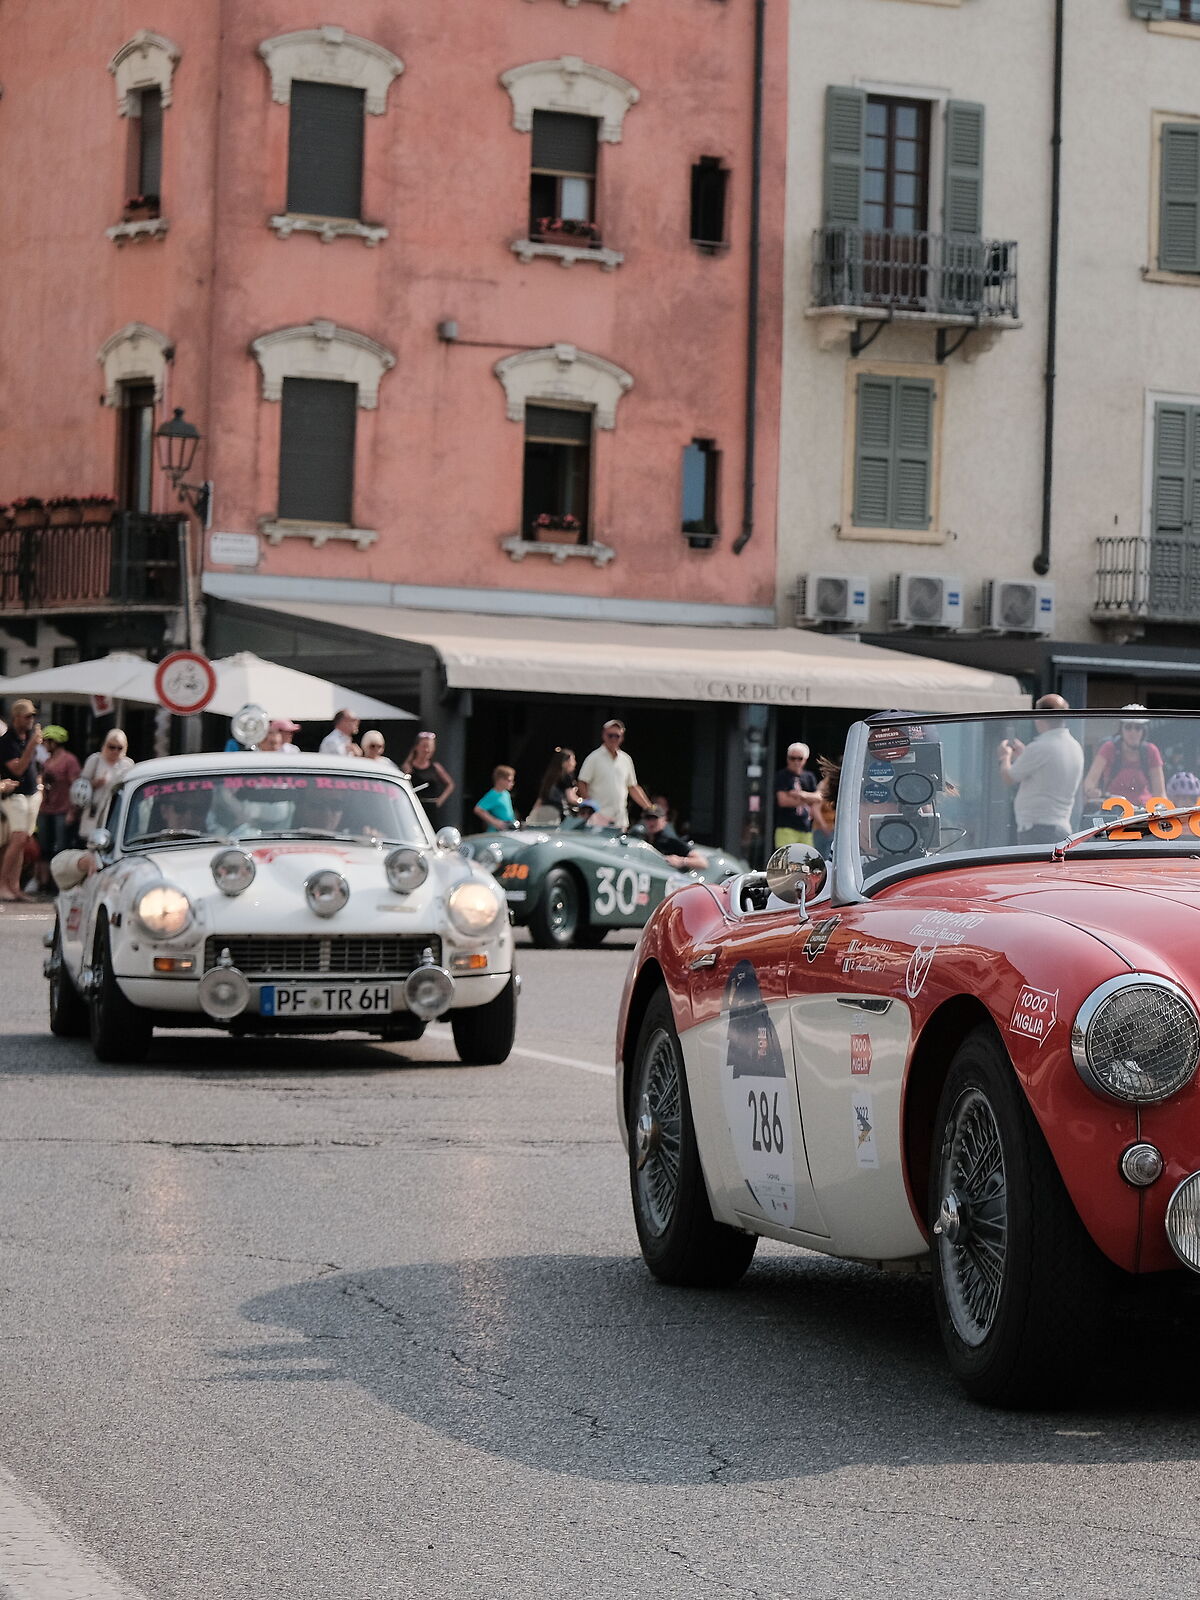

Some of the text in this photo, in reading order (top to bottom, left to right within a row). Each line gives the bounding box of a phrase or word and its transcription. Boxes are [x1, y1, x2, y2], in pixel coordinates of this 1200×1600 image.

[707, 680, 811, 702] CARDUCCI
[143, 776, 400, 800] Extra Mobile Racing
[921, 910, 985, 929] CHOPARD
[909, 924, 966, 946] Classic Racing
[276, 988, 389, 1011] PF TR 6H
[1020, 991, 1049, 1013] 1000
[1012, 1011, 1044, 1036] MIGLIA
[852, 1038, 867, 1052] 1000
[851, 1057, 869, 1071] MIGLIA
[748, 1090, 784, 1154] 286
